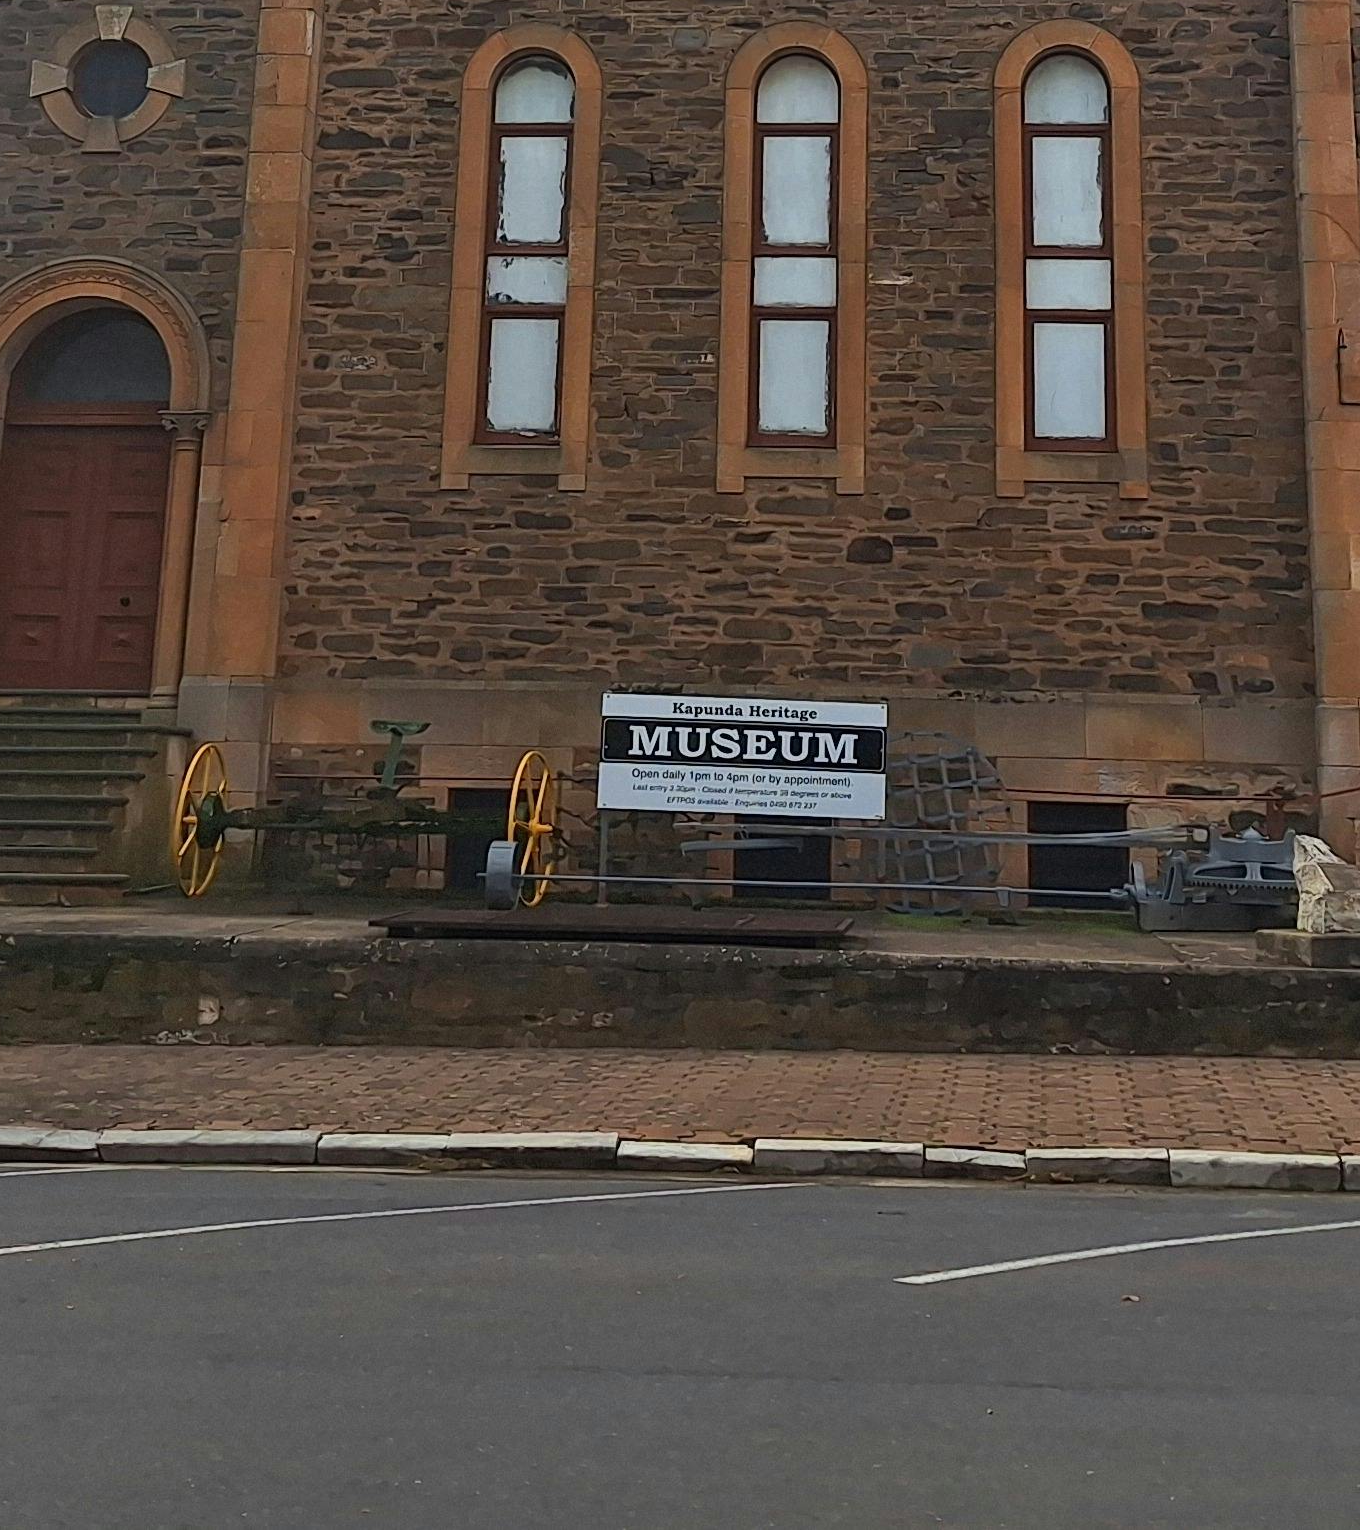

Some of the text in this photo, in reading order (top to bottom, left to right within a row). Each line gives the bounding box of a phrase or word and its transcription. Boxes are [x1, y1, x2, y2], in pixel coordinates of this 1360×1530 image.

[672, 702, 817, 721] Kapunda Heritage
[628, 725, 859, 764] MUSEUM
[632, 768, 659, 780] Open
[662, 769, 686, 781] daily
[690, 770, 710, 782] 1pm
[714, 772, 723, 781] to
[726, 772, 749, 783] 4pm
[752, 773, 766, 784] (or
[769, 773, 781, 786] by
[649, 785, 667, 793] entry
[702, 786, 727, 794] Closed
[735, 787, 778, 798] temperature
[791, 790, 819, 799] degrees
[831, 791, 852, 799] above
[667, 796, 696, 804] EFTPOS
[697, 798, 729, 806] available
